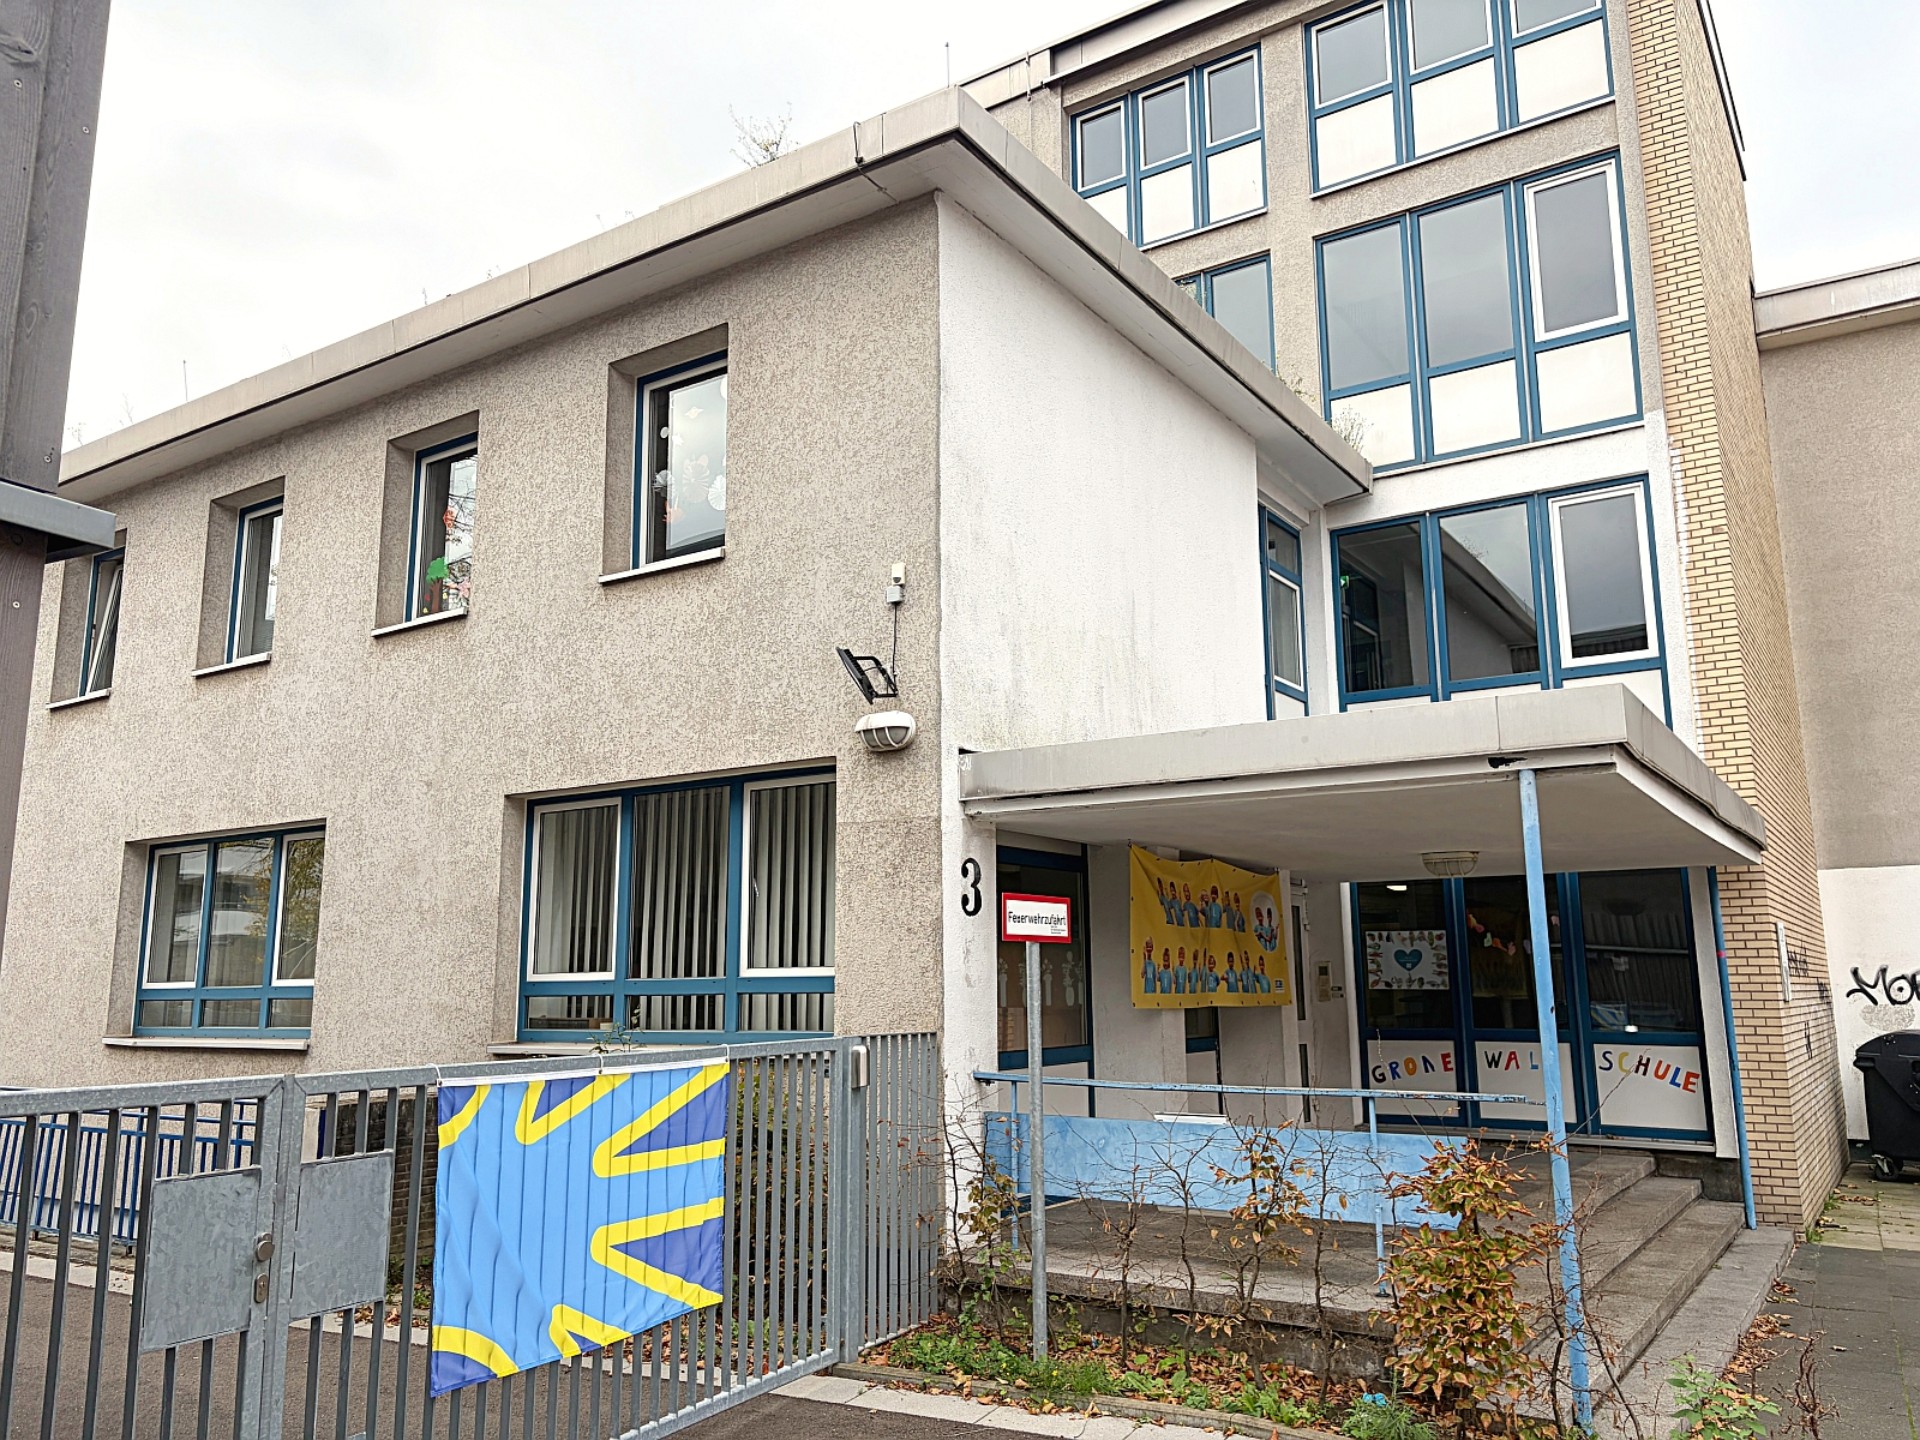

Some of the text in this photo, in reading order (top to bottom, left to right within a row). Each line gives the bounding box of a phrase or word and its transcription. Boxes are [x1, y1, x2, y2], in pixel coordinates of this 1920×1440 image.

[961, 857, 982, 917] 3
[1007, 911, 1067, 926] Feuerwehrzufahrt
[1598, 1050, 1701, 1094] SCHULE
